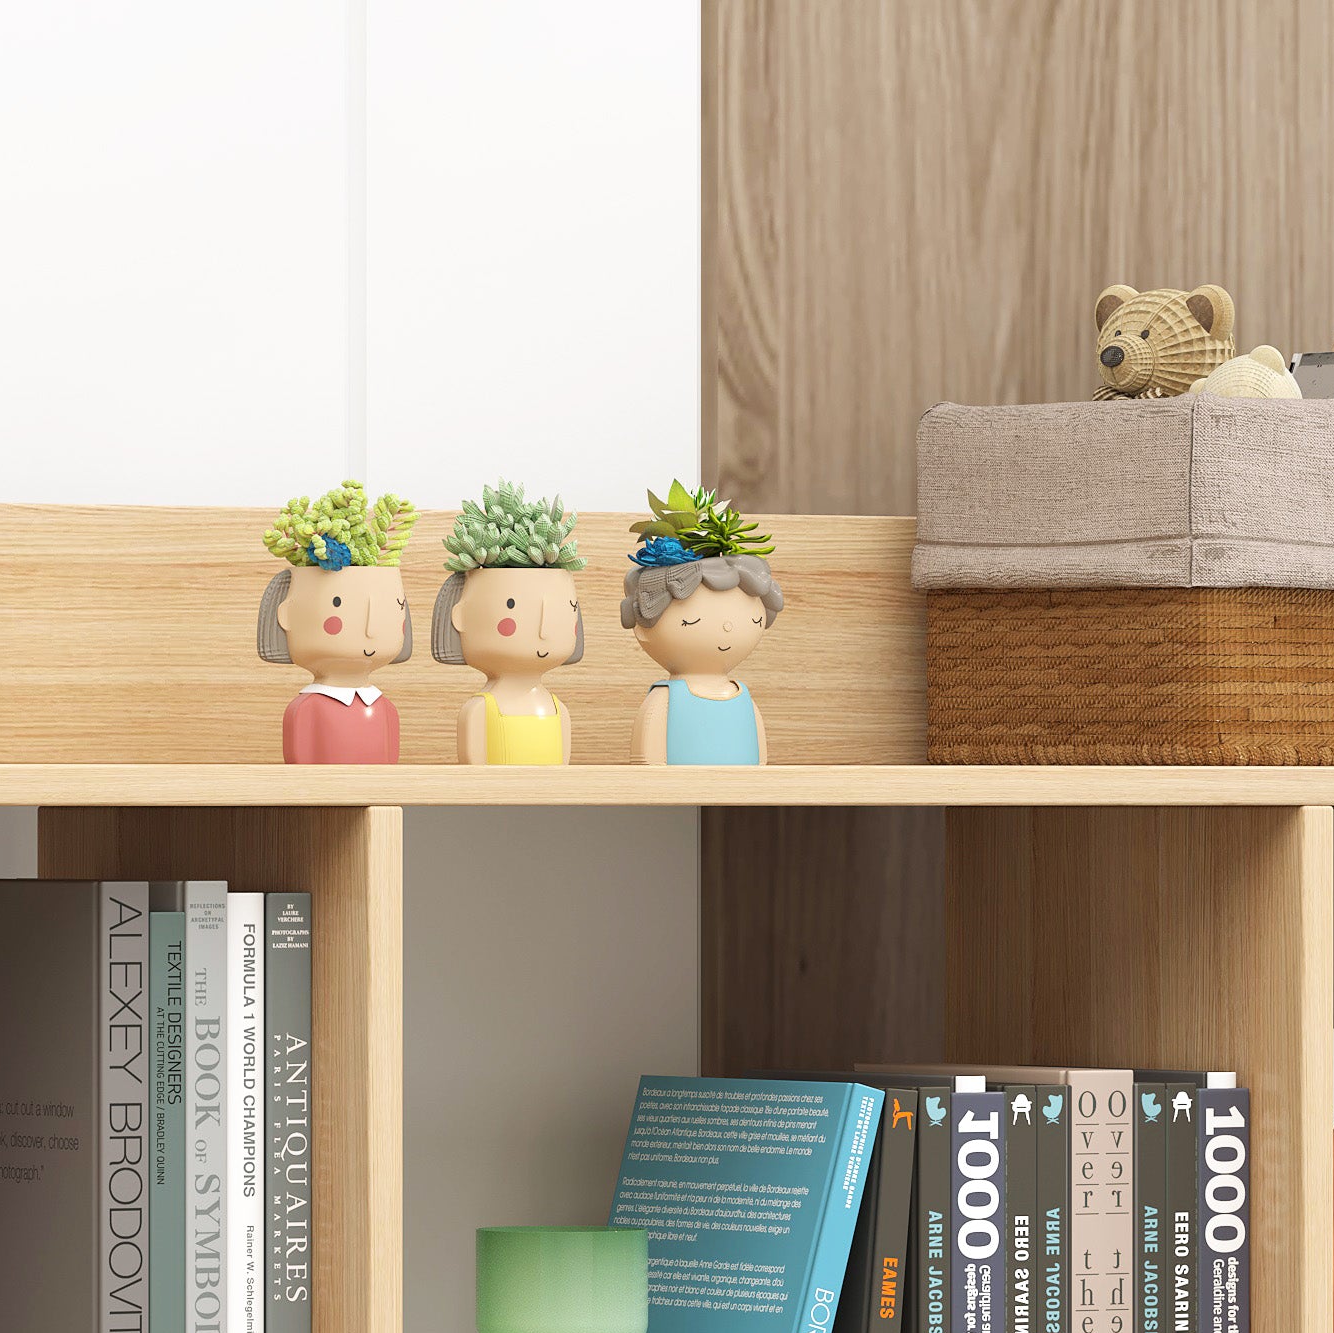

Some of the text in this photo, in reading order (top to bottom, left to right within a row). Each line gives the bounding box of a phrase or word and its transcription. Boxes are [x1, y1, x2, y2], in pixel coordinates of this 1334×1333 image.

[109, 897, 143, 1084] ALEXEY
[195, 968, 207, 1006] THE
[167, 940, 182, 1105] TEXTILE DESIGNERS
[194, 1016, 221, 1129] BOOK
[243, 923, 256, 1198] FORMULA 1 WORLD CHAMPIONS
[156, 1006, 165, 1185] AT THE CUTTING EDGE BRADLEY QUINN
[195, 1139, 207, 1164] OF
[273, 1034, 281, 1301] PARIS FLEA MARKETS
[281, 1033, 308, 1302] ANTIQUAIRES
[1204, 1105, 1246, 1253] 1000
[246, 1225, 254, 1259] Rainer
[928, 1210, 943, 1259] ARNE
[1144, 1205, 1158, 1253] ARNE
[1174, 1212, 1189, 1257] EERO
[246, 1262, 254, 1274] W.
[879, 1257, 899, 1319] EAMES
[1212, 1258, 1225, 1315] Geraldine
[1225, 1256, 1240, 1304] designs
[1227, 1304, 1240, 1322] for
